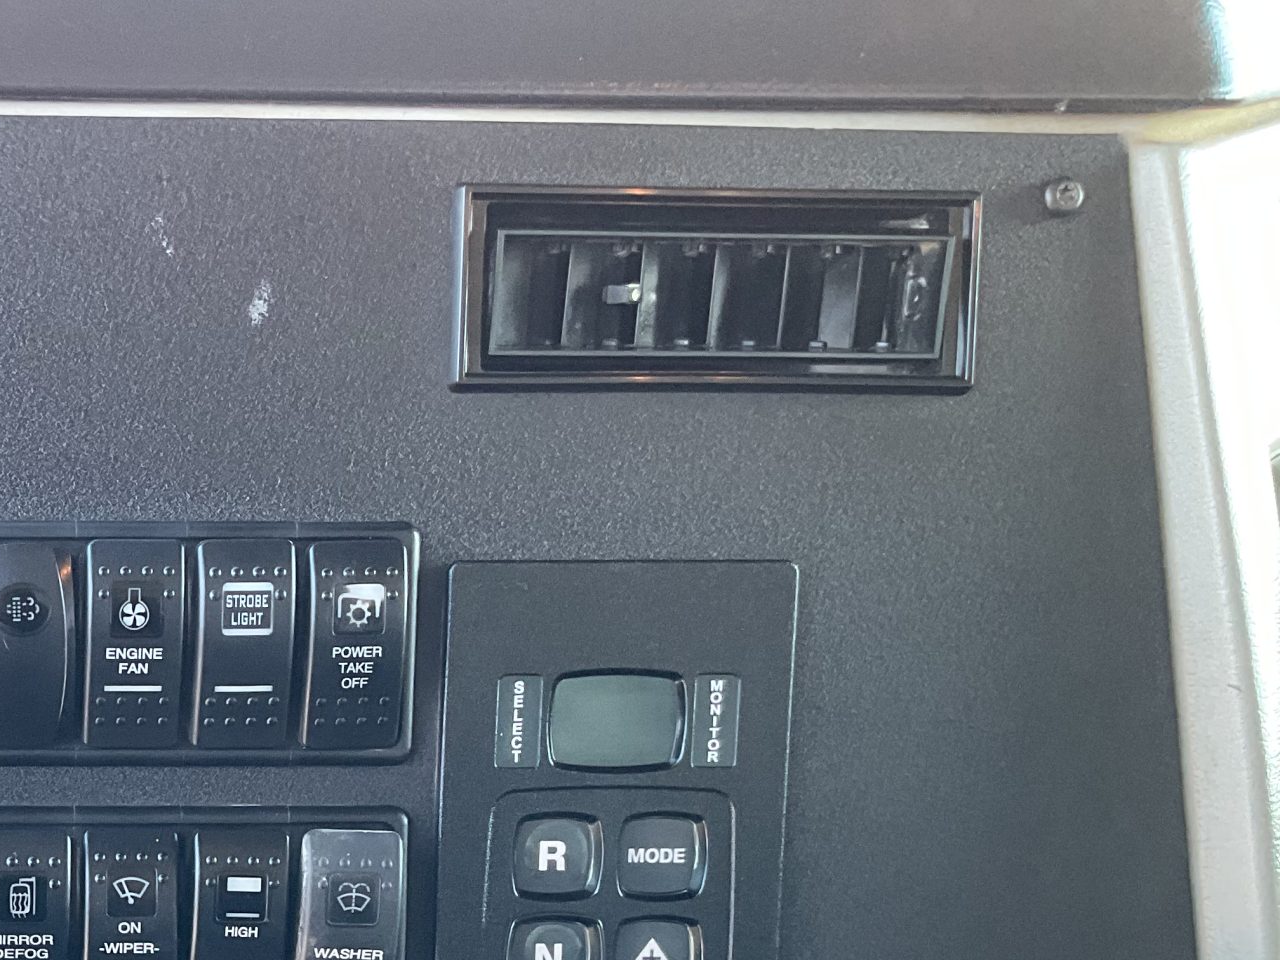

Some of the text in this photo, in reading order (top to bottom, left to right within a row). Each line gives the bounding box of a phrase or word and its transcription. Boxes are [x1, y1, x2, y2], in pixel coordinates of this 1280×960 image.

[225, 594, 269, 608] STROBE
[231, 611, 264, 626] LIGHT
[105, 647, 164, 660] ENGINE
[332, 645, 383, 659] POWER
[118, 662, 149, 675] FAN
[338, 661, 374, 674] TAKE
[341, 677, 369, 689] OFF
[510, 680, 525, 763] SELECT
[706, 679, 724, 763] MONITOR
[538, 840, 567, 872] R
[627, 847, 686, 864] MODE
[117, 921, 142, 934] ON
[224, 925, 259, 938] HIGH
[98, 942, 160, 954] -WIPER-
[313, 947, 384, 960] WASHER
